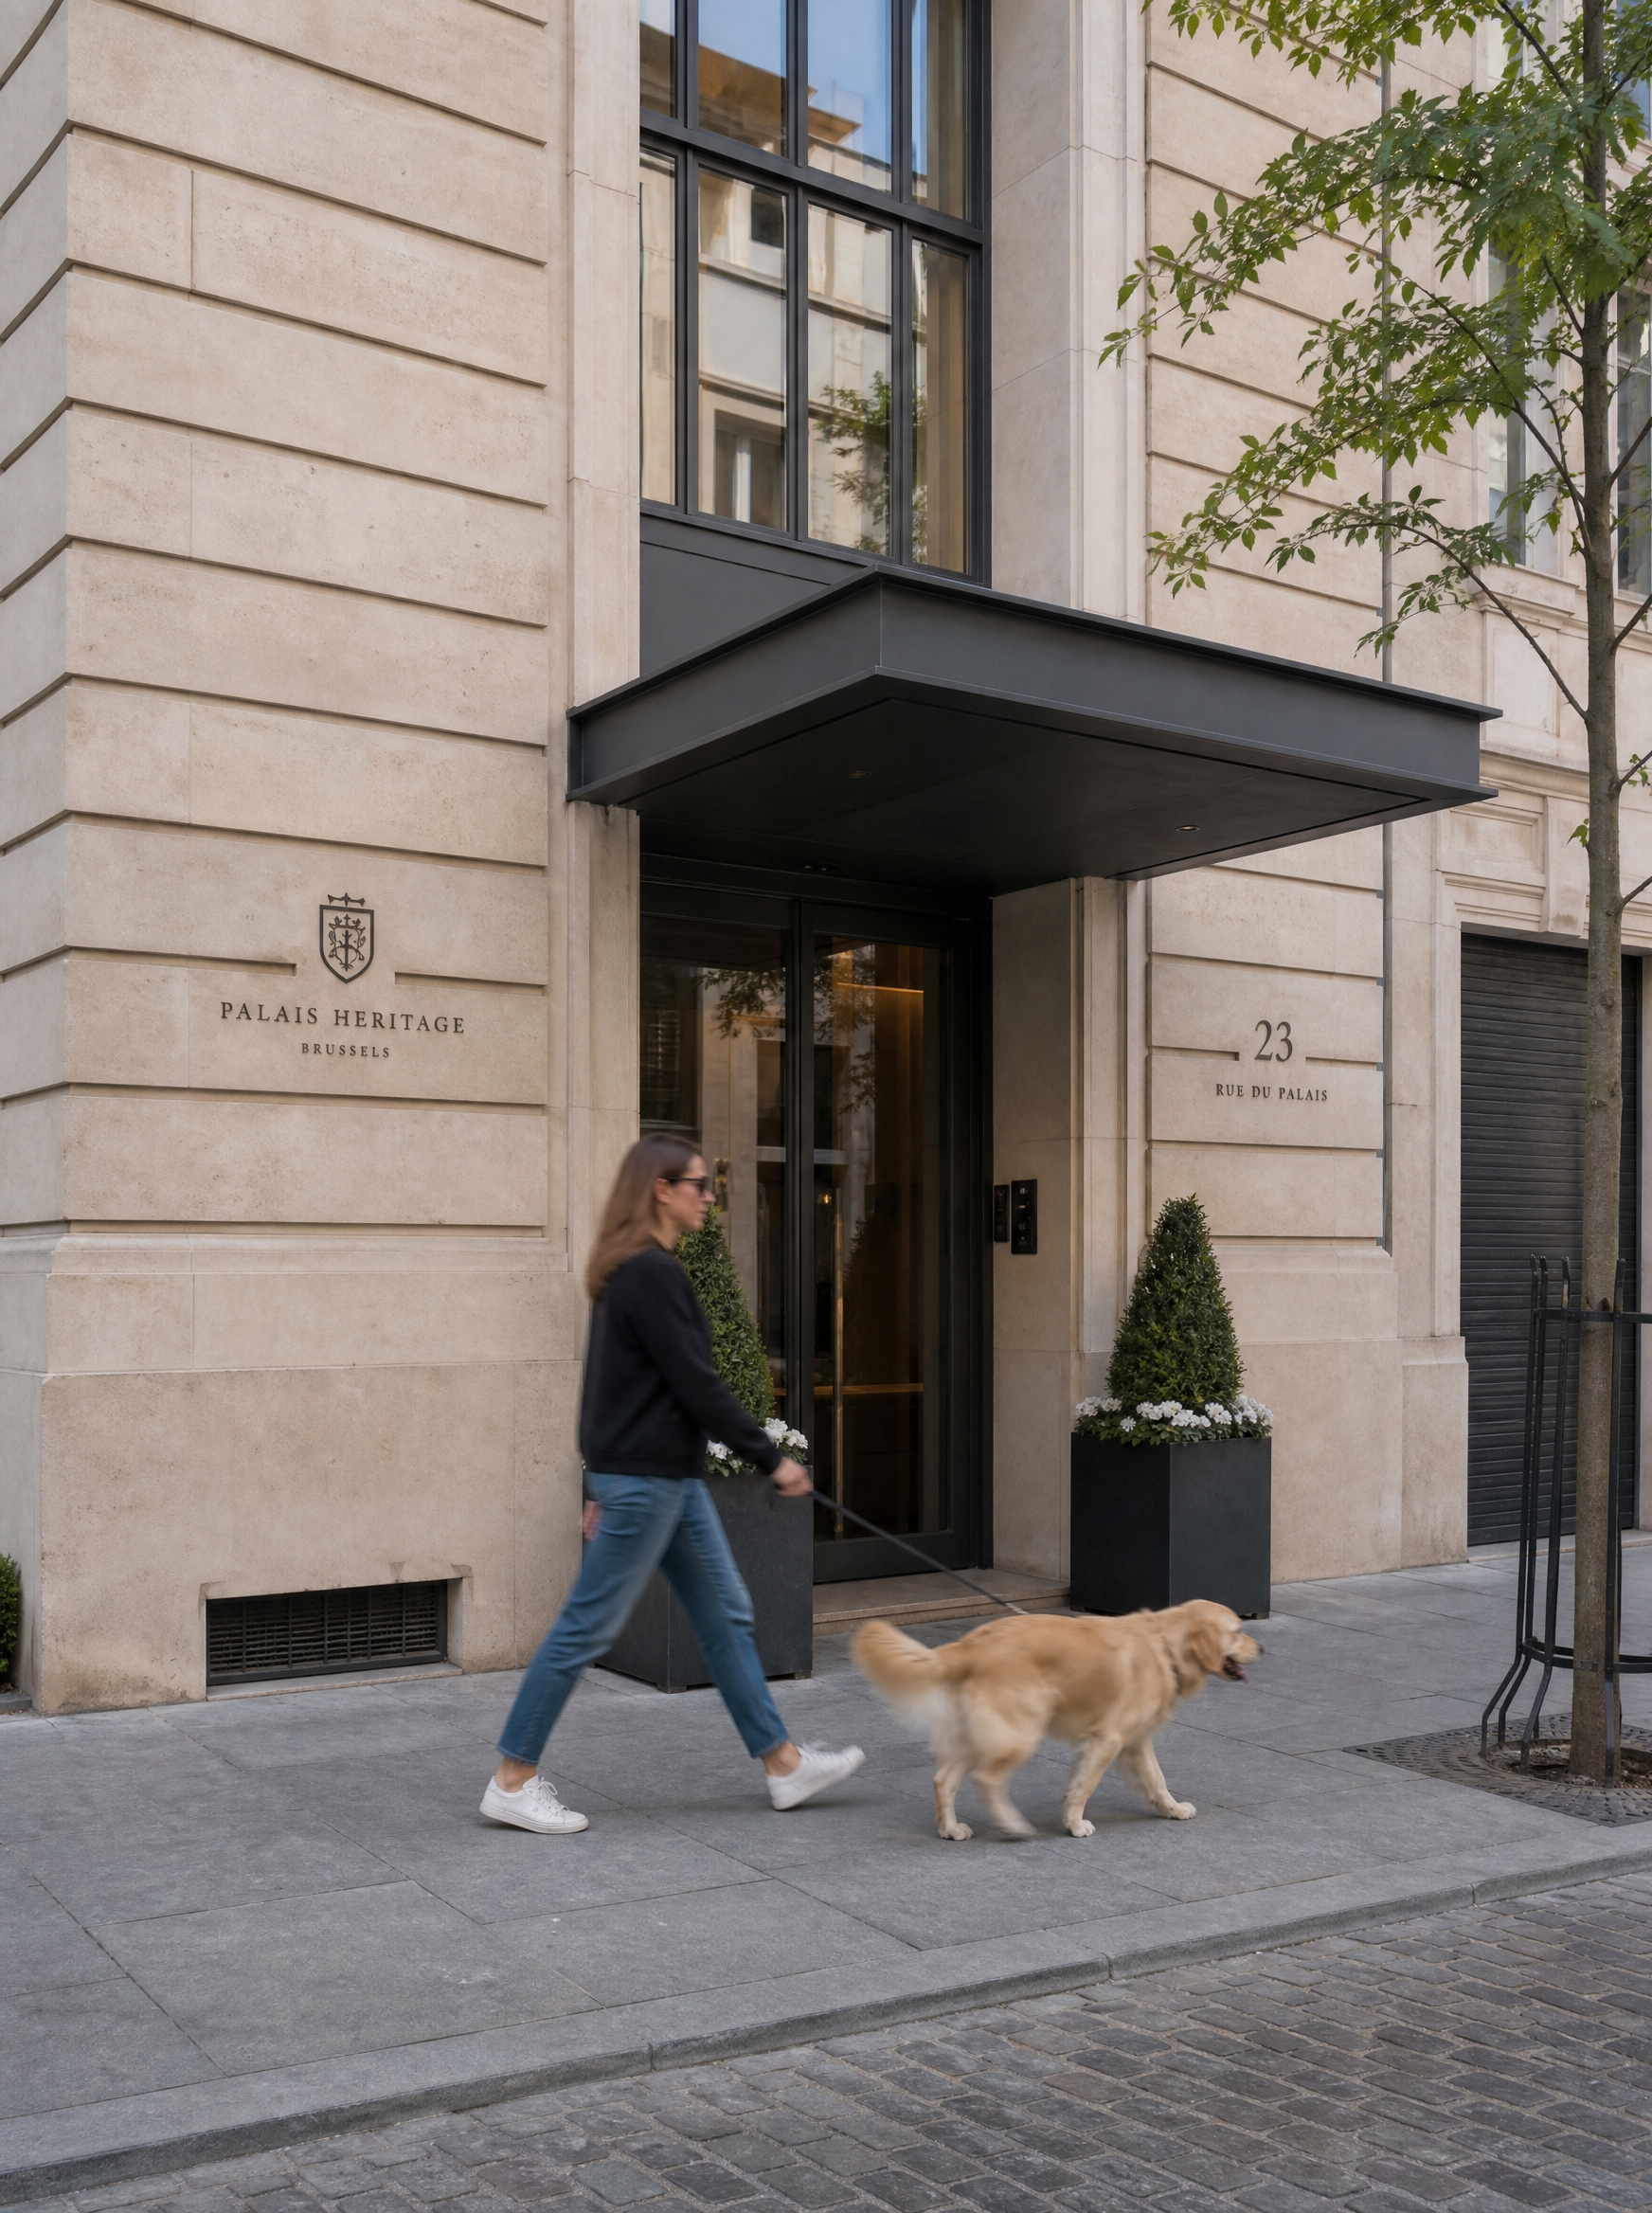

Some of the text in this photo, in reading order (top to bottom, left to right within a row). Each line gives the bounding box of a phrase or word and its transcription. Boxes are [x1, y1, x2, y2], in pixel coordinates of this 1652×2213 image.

[221, 1001, 465, 1034] PALAIS HERITAGE
[301, 1043, 390, 1057] BRUSSELS
[1254, 1019, 1293, 1062] 23
[1216, 1083, 1327, 1102] RUE DU PALAIS
